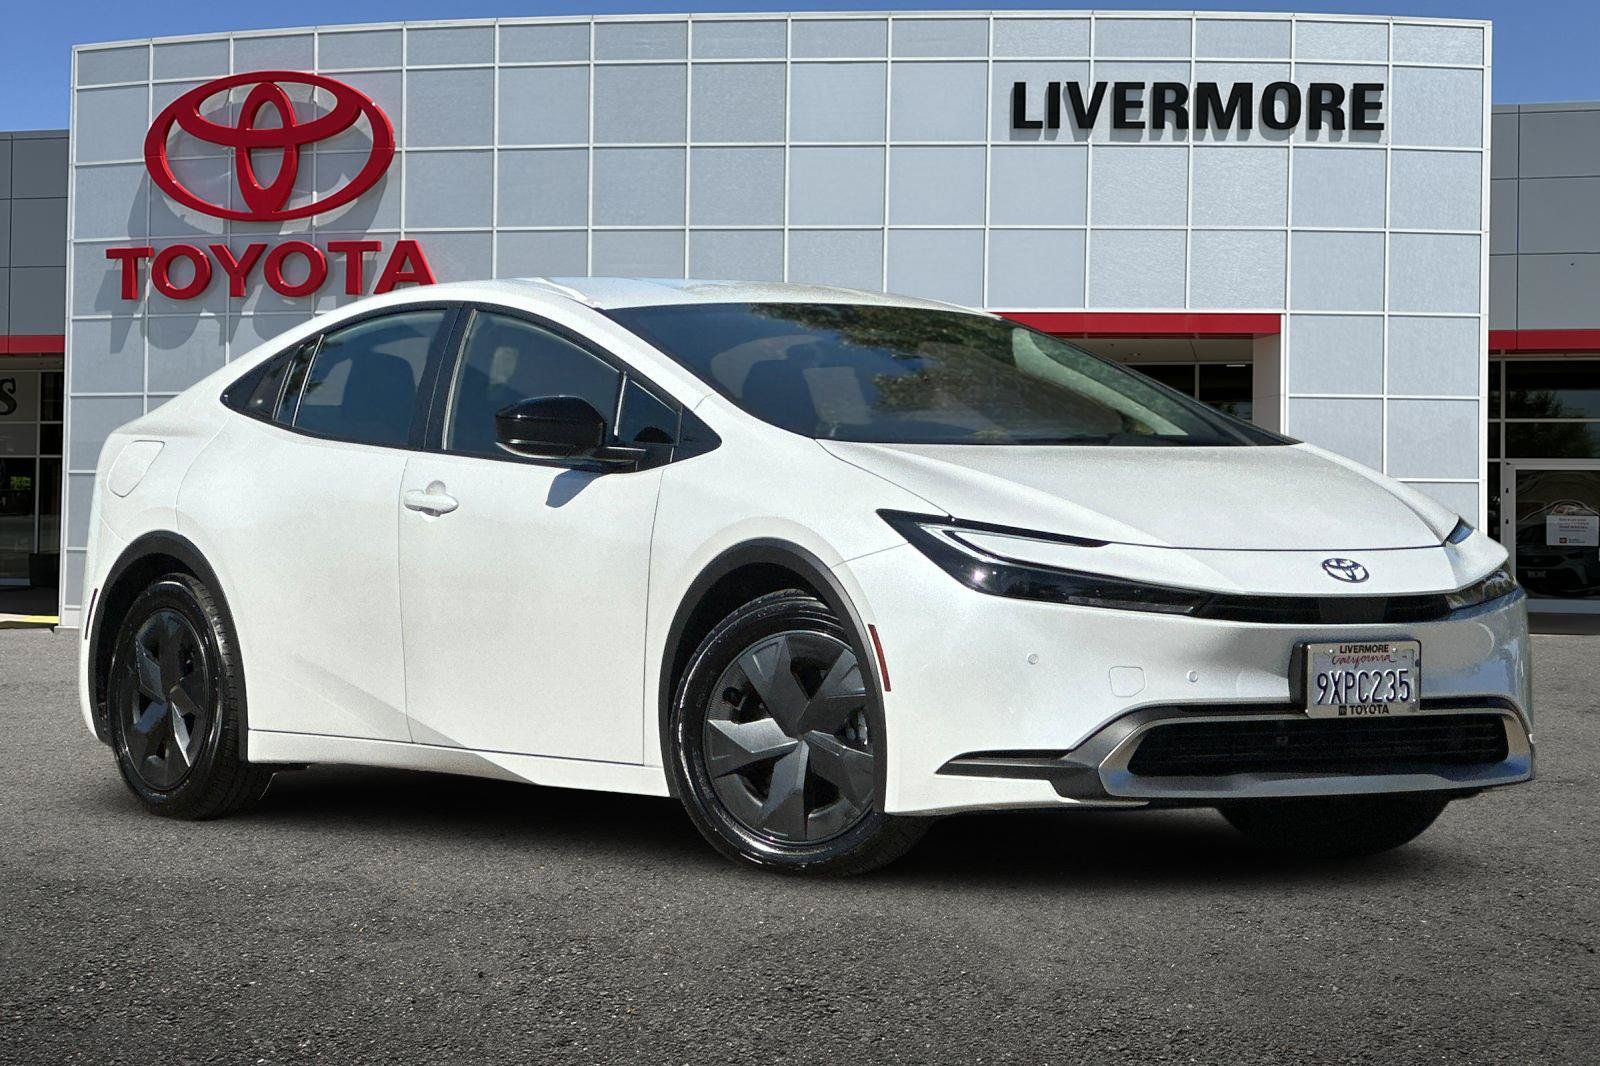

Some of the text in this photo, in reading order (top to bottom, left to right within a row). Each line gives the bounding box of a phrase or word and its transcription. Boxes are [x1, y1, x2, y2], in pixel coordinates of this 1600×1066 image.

[1013, 81, 1385, 131] LIVERMORE
[106, 239, 437, 301] TOYOTA
[1339, 644, 1389, 654] LIVERMORE
[1331, 655, 1397, 669] California
[1316, 669, 1411, 705] 9XPC235
[1349, 703, 1390, 715] TOYOTA
